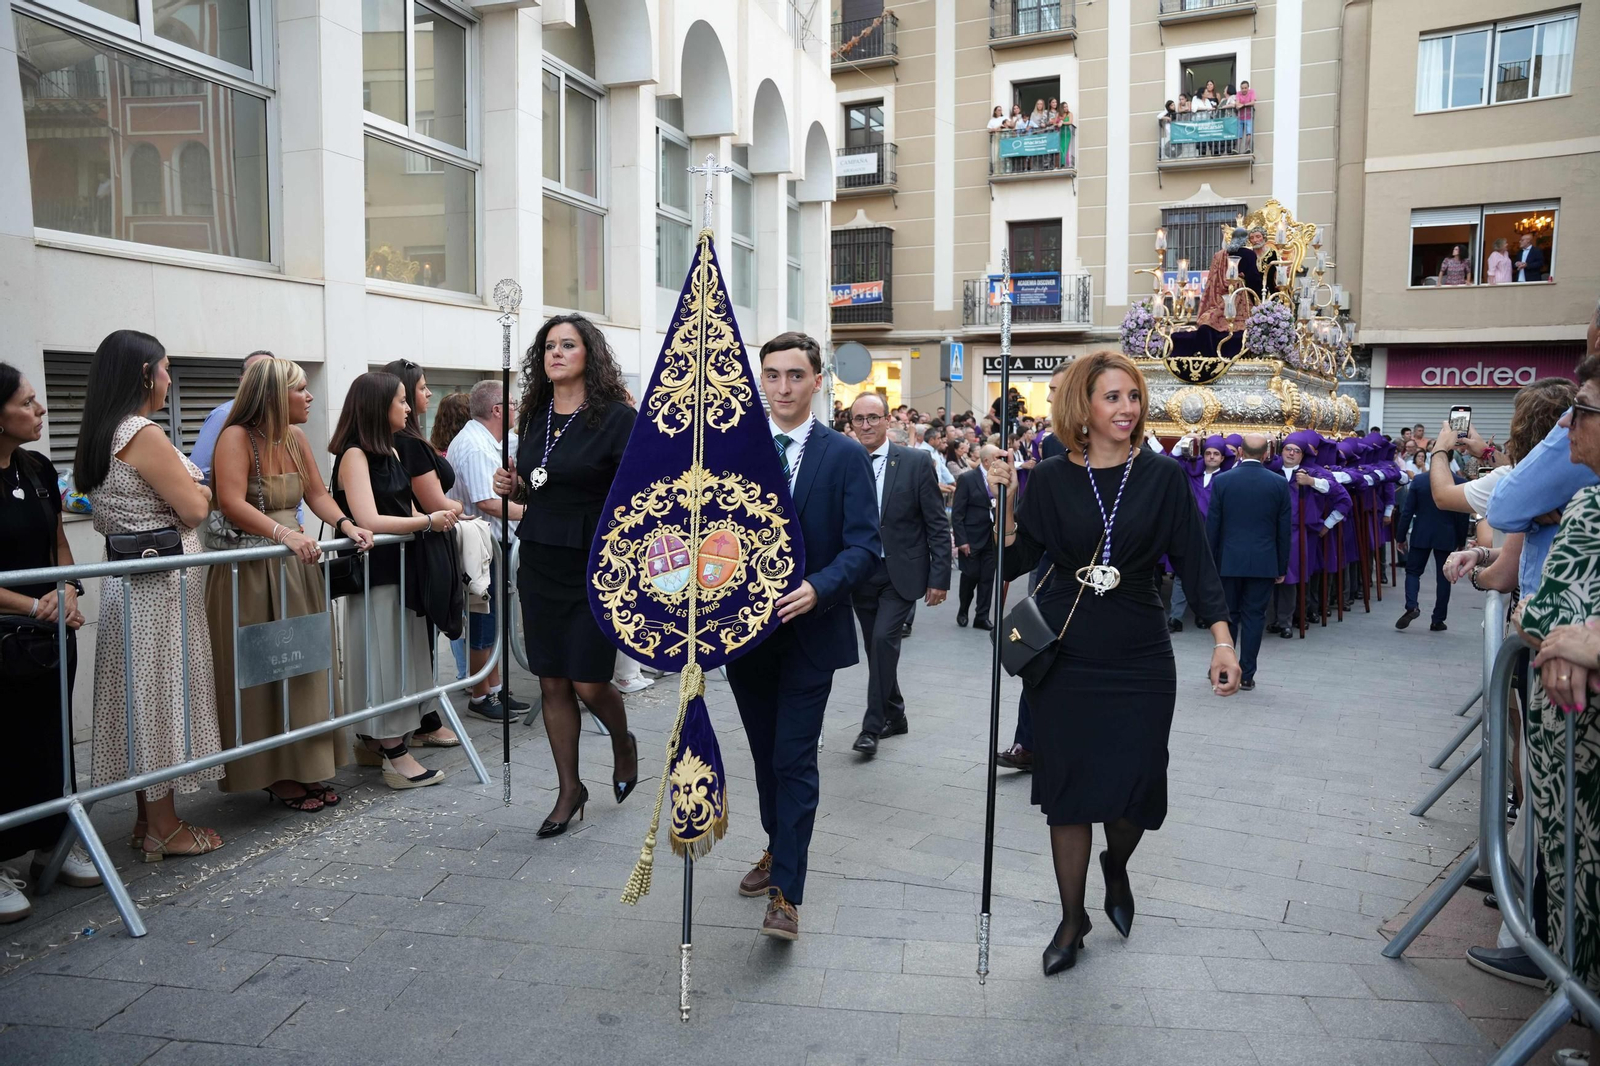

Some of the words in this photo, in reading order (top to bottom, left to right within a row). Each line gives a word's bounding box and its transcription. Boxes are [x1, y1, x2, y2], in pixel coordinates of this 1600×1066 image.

[840, 158, 869, 166] CAMPAÑA
[1017, 279, 1037, 287] ACADEMIA
[832, 286, 879, 301] ISCOVER
[986, 358, 1024, 369] LOA
[1421, 361, 1537, 386] andrea
[664, 604, 676, 614] TU
[675, 608, 688, 618] ES
[696, 600, 720, 617] ETRUS
